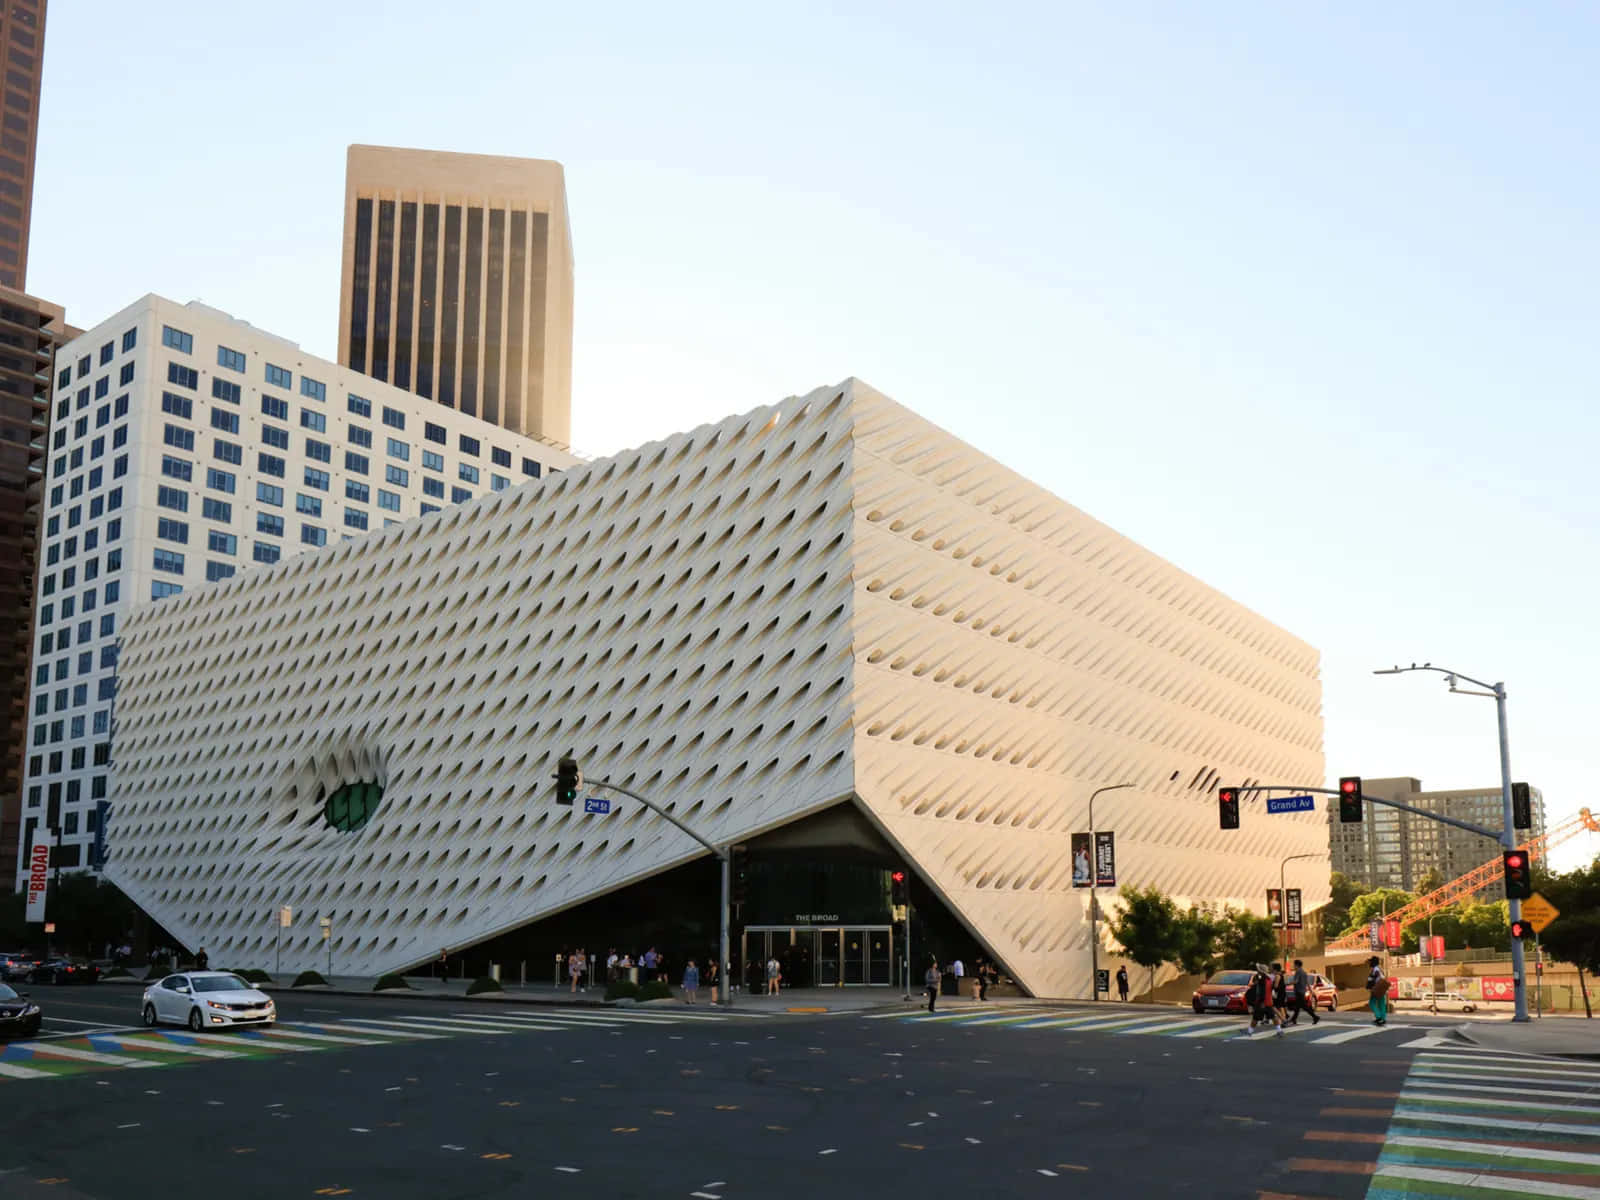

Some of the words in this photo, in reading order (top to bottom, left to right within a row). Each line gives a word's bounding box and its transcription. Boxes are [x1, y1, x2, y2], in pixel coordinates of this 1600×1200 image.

[1271, 800, 1297, 810] Grand
[1299, 799, 1311, 807] Av
[30, 845, 48, 891] BROAD
[29, 892, 38, 904] THE
